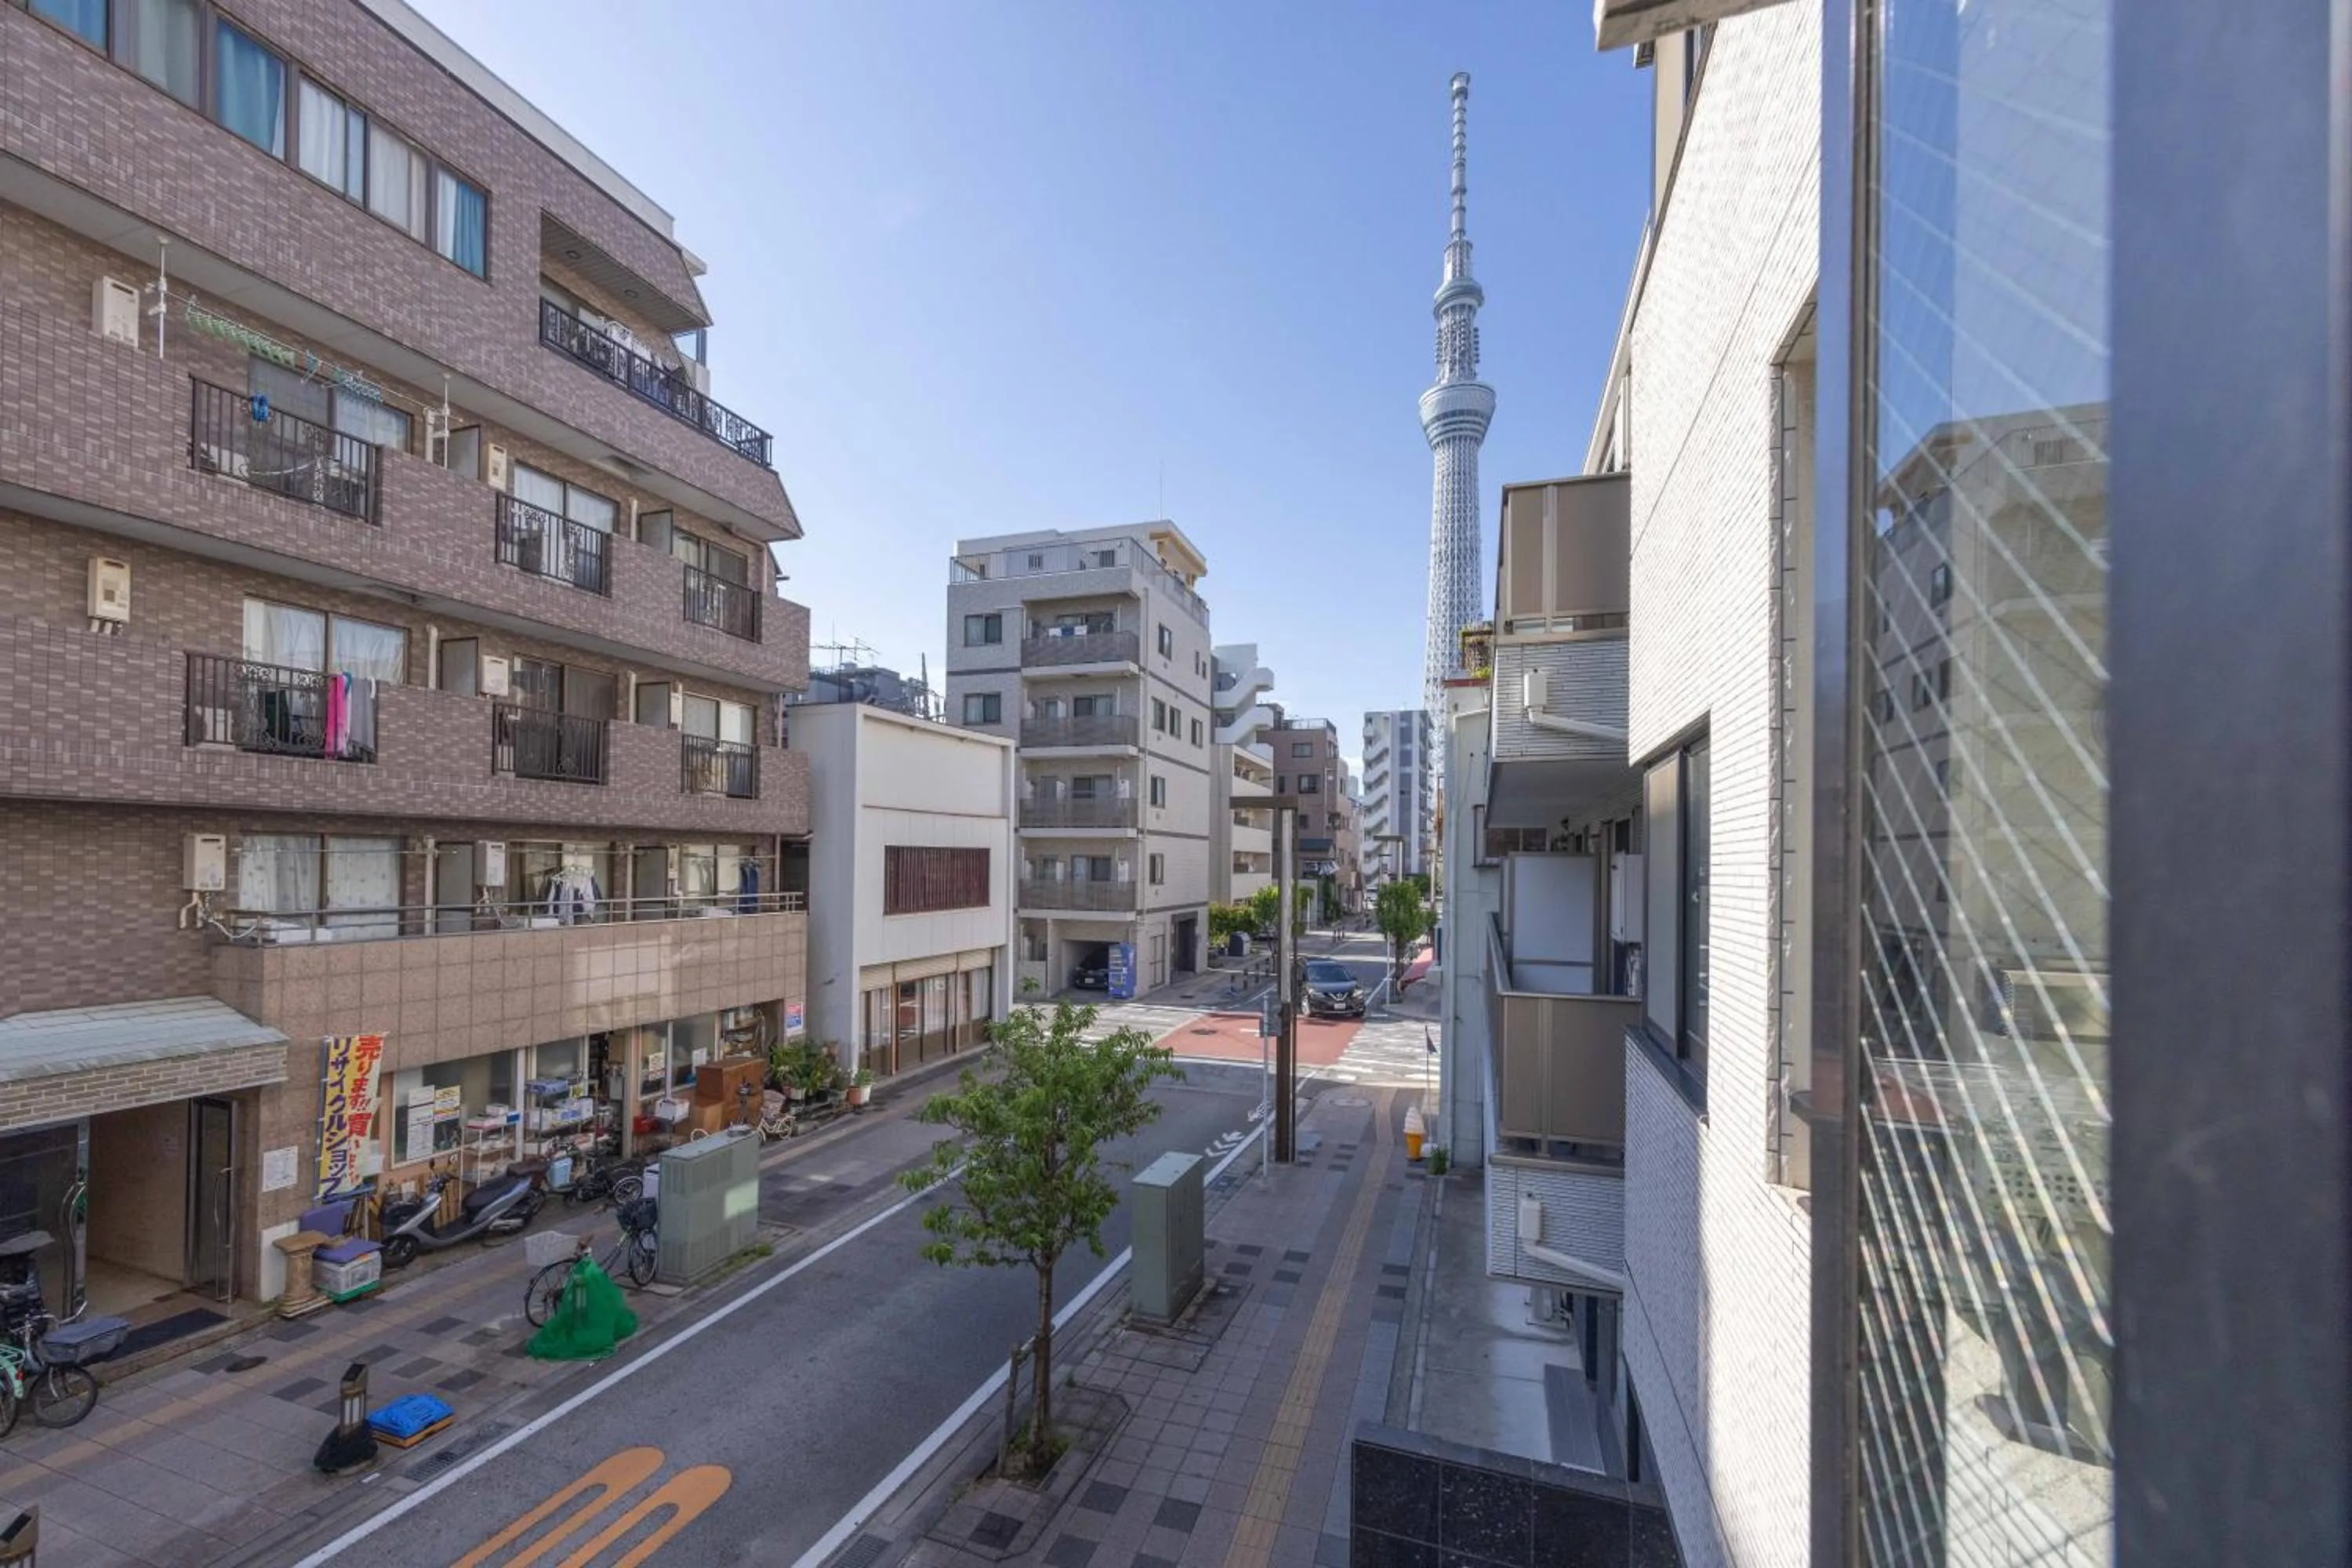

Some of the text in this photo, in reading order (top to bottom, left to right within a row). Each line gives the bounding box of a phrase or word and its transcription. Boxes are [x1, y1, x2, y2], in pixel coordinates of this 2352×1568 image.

[321, 1037, 351, 1199] リサイクルショップ
